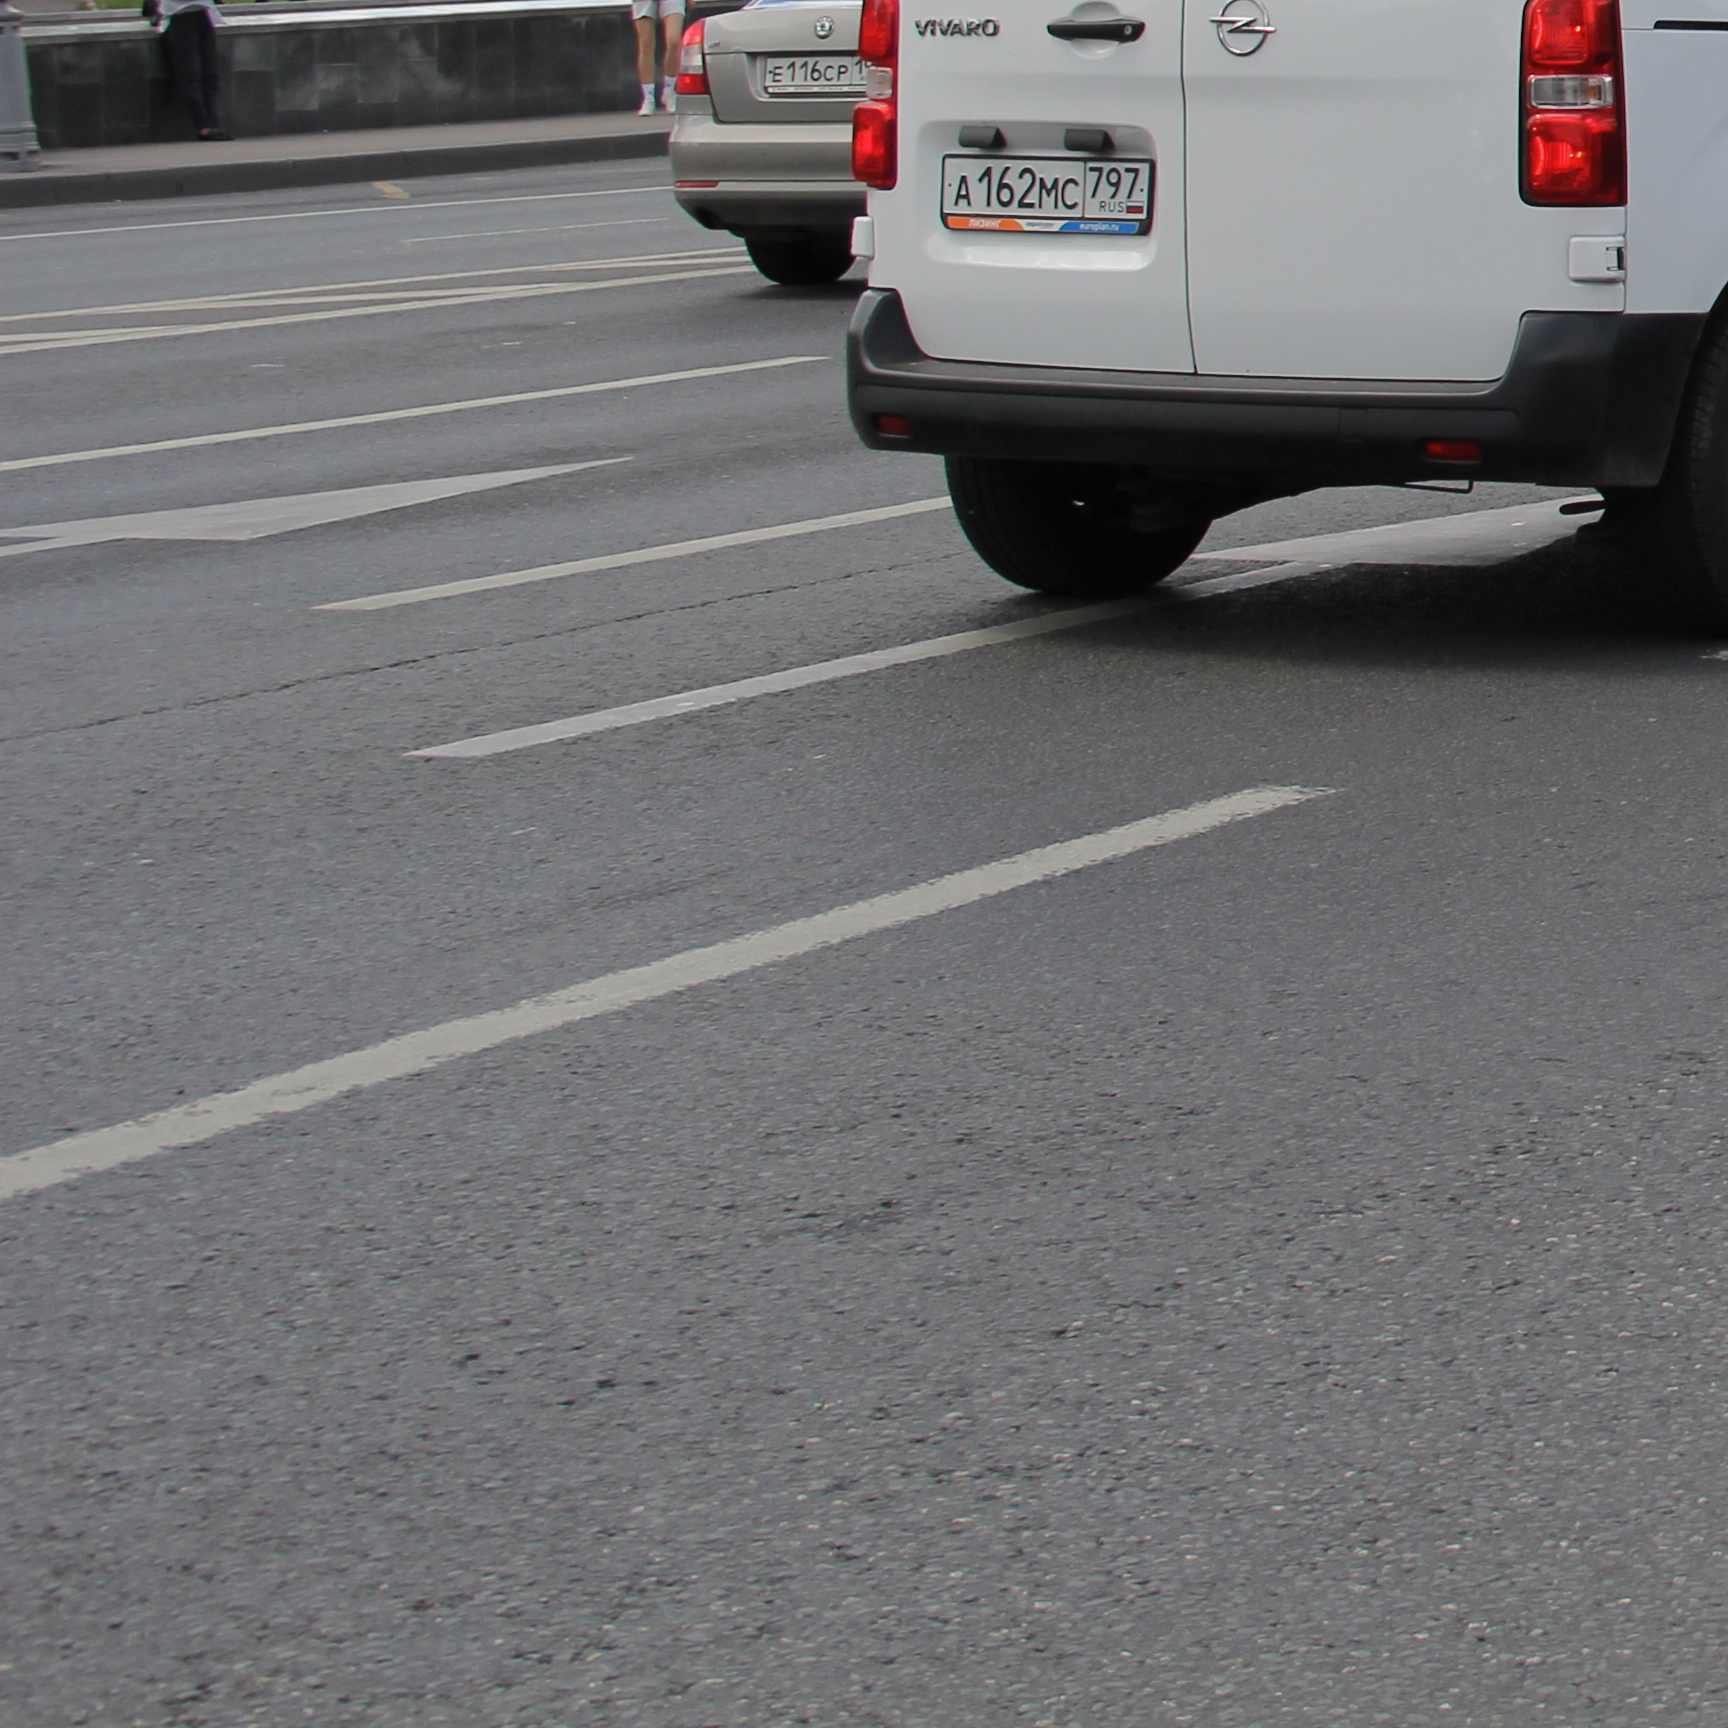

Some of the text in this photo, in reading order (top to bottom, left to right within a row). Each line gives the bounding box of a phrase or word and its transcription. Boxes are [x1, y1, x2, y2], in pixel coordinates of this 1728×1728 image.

[914, 17, 1000, 38] VIVARO
[771, 60, 849, 83] Е116СР
[953, 166, 1140, 210] А162МС 797
[1099, 200, 1125, 214] RUS
